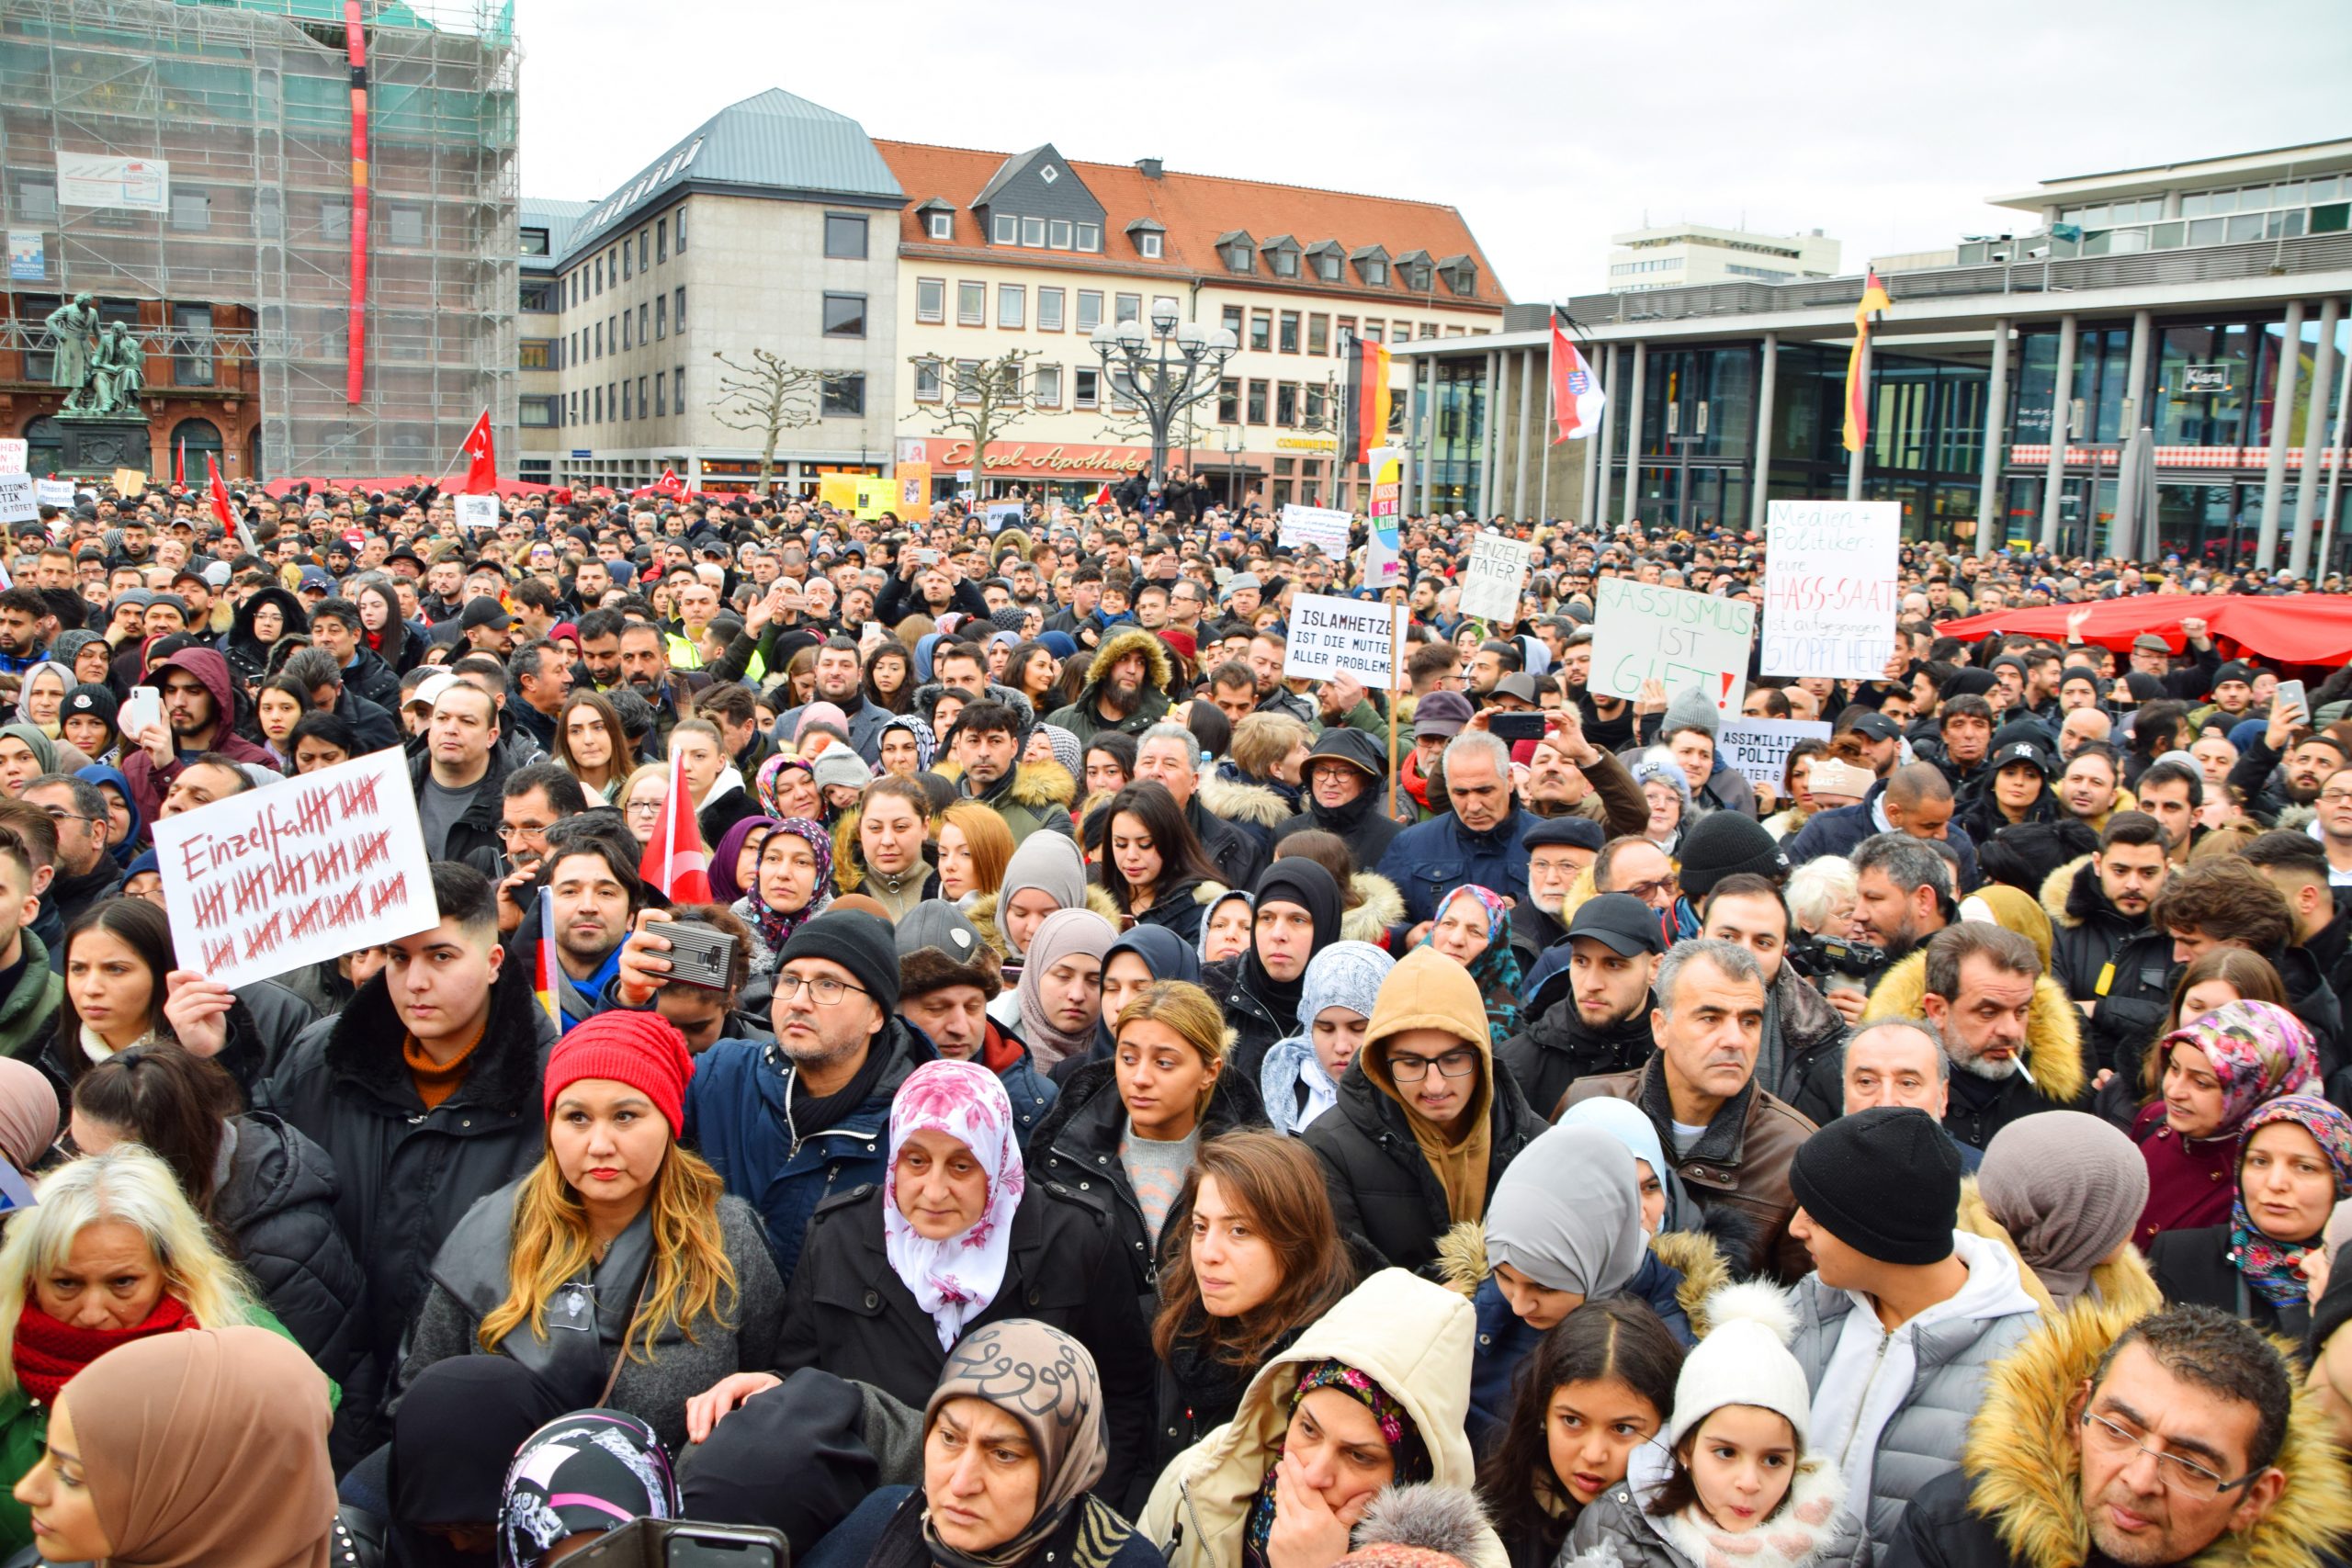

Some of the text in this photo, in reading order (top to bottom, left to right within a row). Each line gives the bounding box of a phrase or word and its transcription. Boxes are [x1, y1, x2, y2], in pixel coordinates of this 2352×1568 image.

[2187, 368, 2222, 383] Klara
[0, 492, 20, 503] TIK
[1772, 503, 1855, 528] Medien
[1772, 526, 1874, 551] Politiker:
[1473, 538, 1527, 565] EINZEL-
[1776, 560, 1808, 572] eure
[1770, 576, 1896, 612] HASS-SAAT
[1597, 579, 1749, 635] RASSISMUS
[1301, 609, 1391, 636] ISLAMHETZE
[1768, 612, 1882, 637] ist aufgegangen
[1295, 630, 1391, 655] IST DIE MUTTE
[1657, 626, 1705, 658] IST
[1765, 636, 1841, 671] STOPPT
[1293, 649, 1391, 674] ALLER PROBLEME
[1724, 732, 1812, 748] ASSIMILATI
[1737, 747, 1790, 764] POLIT
